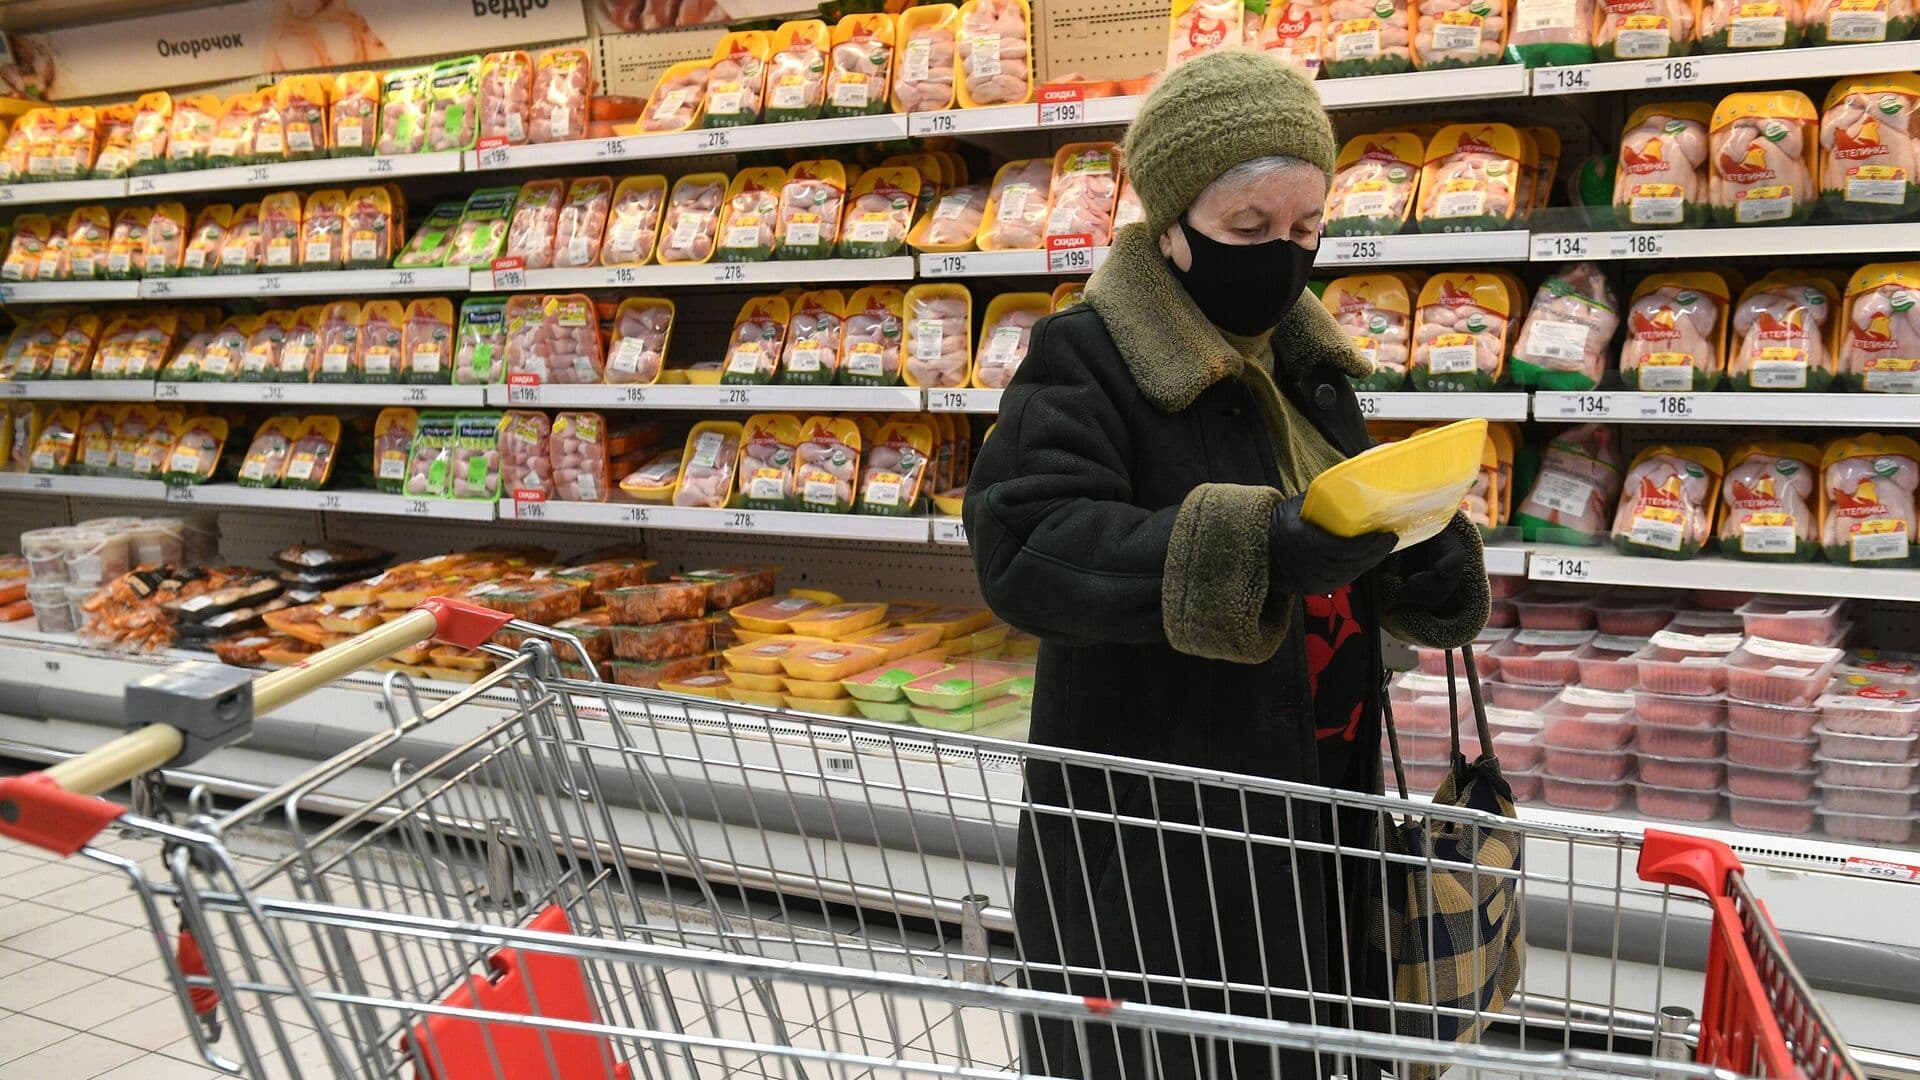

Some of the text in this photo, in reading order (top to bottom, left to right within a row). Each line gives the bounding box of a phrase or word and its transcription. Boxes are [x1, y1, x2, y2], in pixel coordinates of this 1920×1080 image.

[157, 33, 243, 58] Окорочок
[1665, 62, 1692, 79] 186
[1558, 70, 1583, 87] 134
[1044, 90, 1077, 101] СКИДКА
[1056, 105, 1075, 120] 199
[933, 115, 951, 130] 179
[708, 132, 725, 146] 278
[607, 141, 622, 154] 185
[1053, 237, 1086, 247] СКИДКА
[1555, 238, 1580, 254] 134
[1630, 236, 1656, 252] 186
[1352, 242, 1376, 257] 253
[943, 257, 961, 271] 179
[1065, 251, 1084, 266] 199
[617, 269, 632, 281] 185
[725, 266, 741, 279] 278
[627, 388, 642, 401] 185
[730, 389, 746, 402] 278
[944, 393, 962, 407] 179
[1360, 398, 1374, 413] 53
[1579, 397, 1604, 412] 134
[1660, 397, 1686, 413] 186
[527, 504, 542, 517] 199
[631, 508, 646, 520] 185
[735, 513, 751, 526] 278
[1558, 560, 1582, 576] 134
